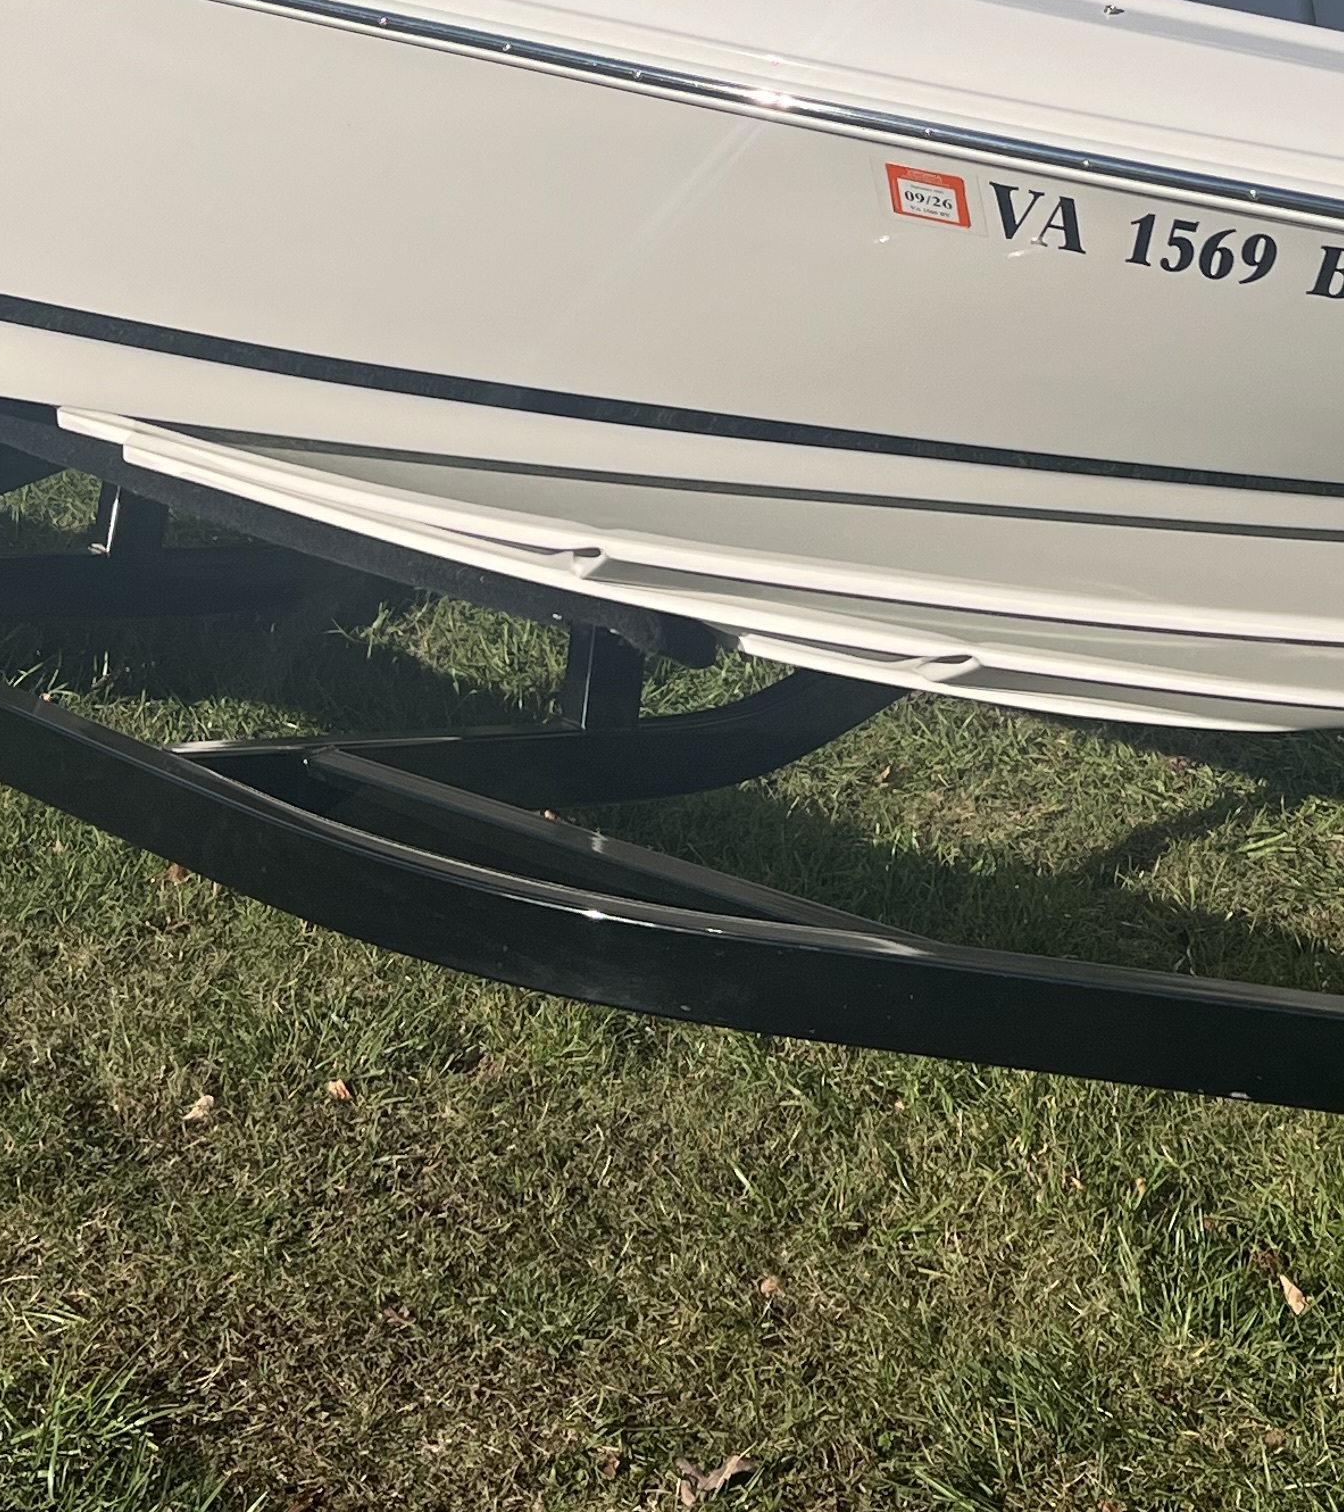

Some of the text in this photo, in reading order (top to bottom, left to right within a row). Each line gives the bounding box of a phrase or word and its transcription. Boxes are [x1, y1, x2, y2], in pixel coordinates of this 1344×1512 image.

[904, 190, 953, 210] 09/26
[987, 181, 1087, 255] VA
[1124, 212, 1278, 285] 1569
